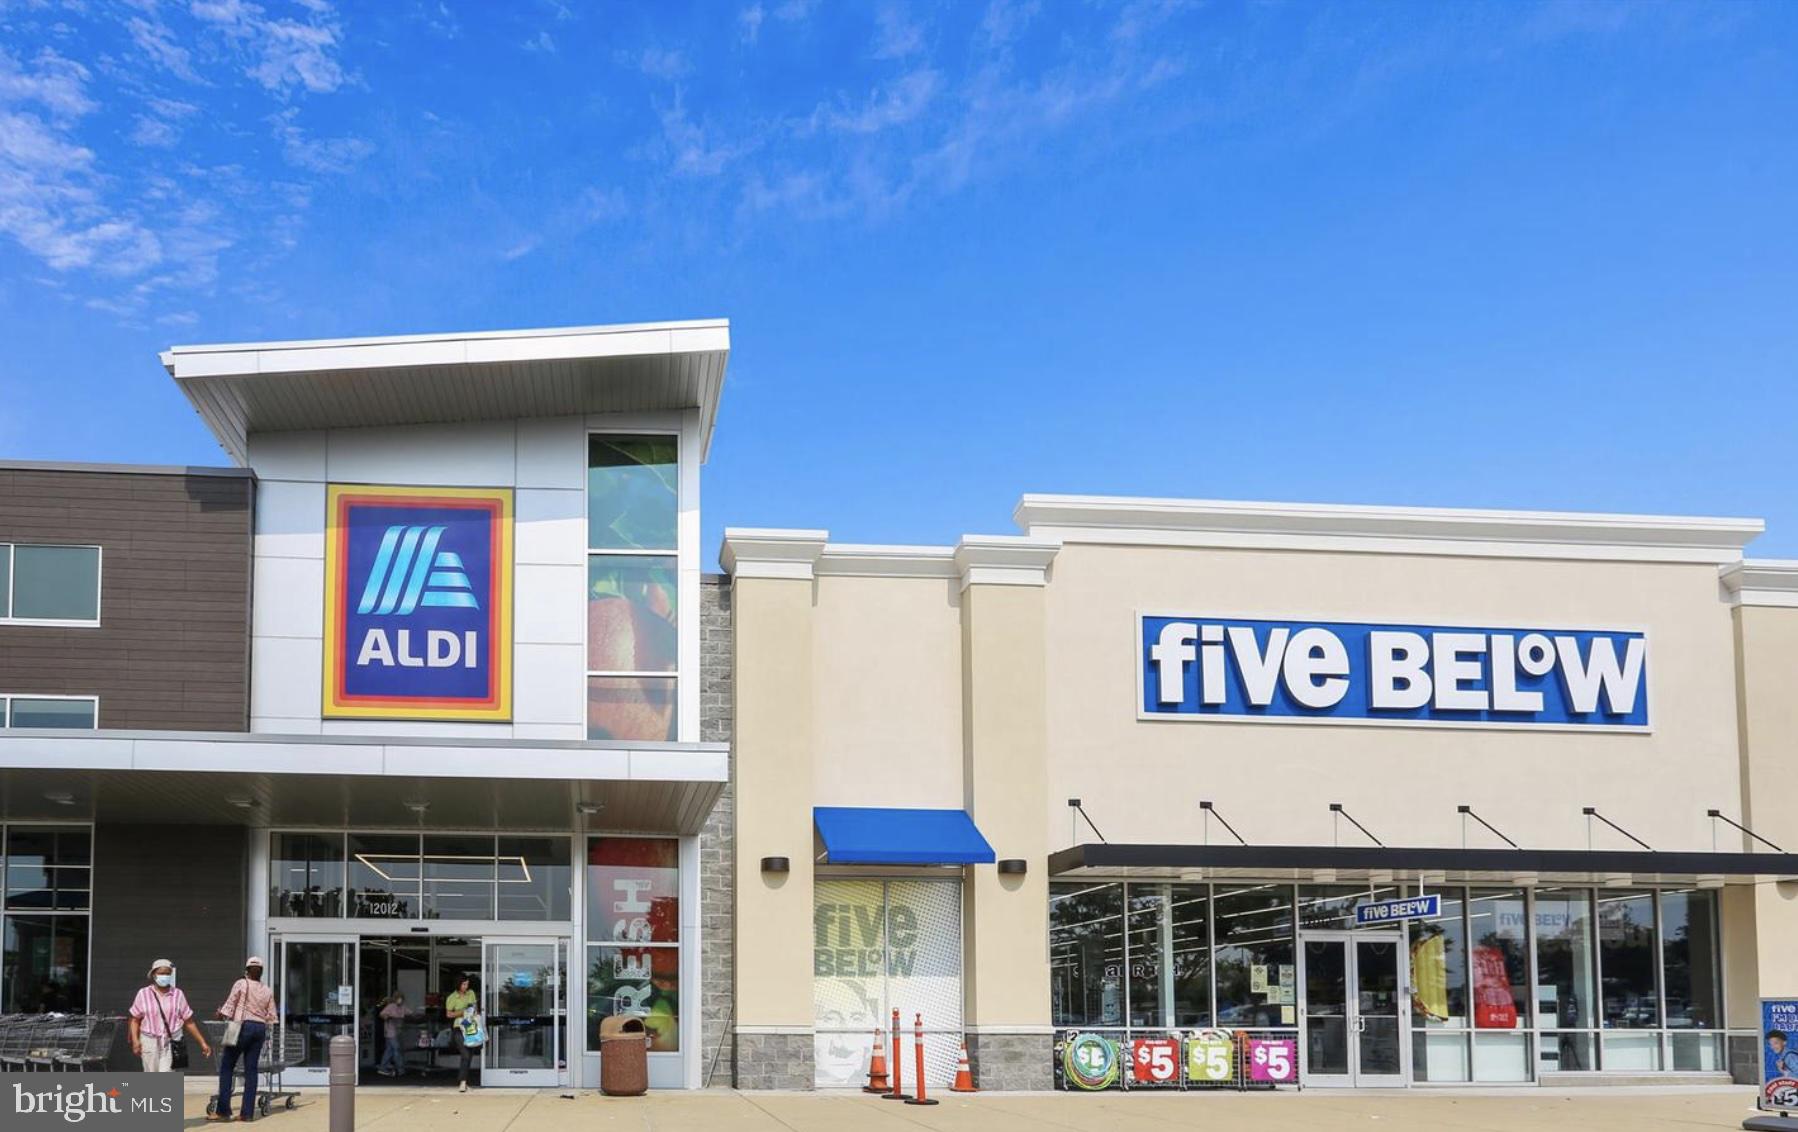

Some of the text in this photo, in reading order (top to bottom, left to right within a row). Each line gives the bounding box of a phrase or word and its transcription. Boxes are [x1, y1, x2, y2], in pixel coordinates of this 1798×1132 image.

[356, 628, 478, 668] ALDI
[1151, 622, 1647, 713] five BELOW
[370, 902, 399, 915] 12012
[1363, 900, 1430, 919] five BELOW
[814, 904, 917, 949] five
[613, 879, 652, 1017] RESH
[814, 948, 915, 977] BELOW
[1138, 1046, 1174, 1079] $5
[1193, 1045, 1229, 1080] $5
[1255, 1045, 1291, 1079] $5
